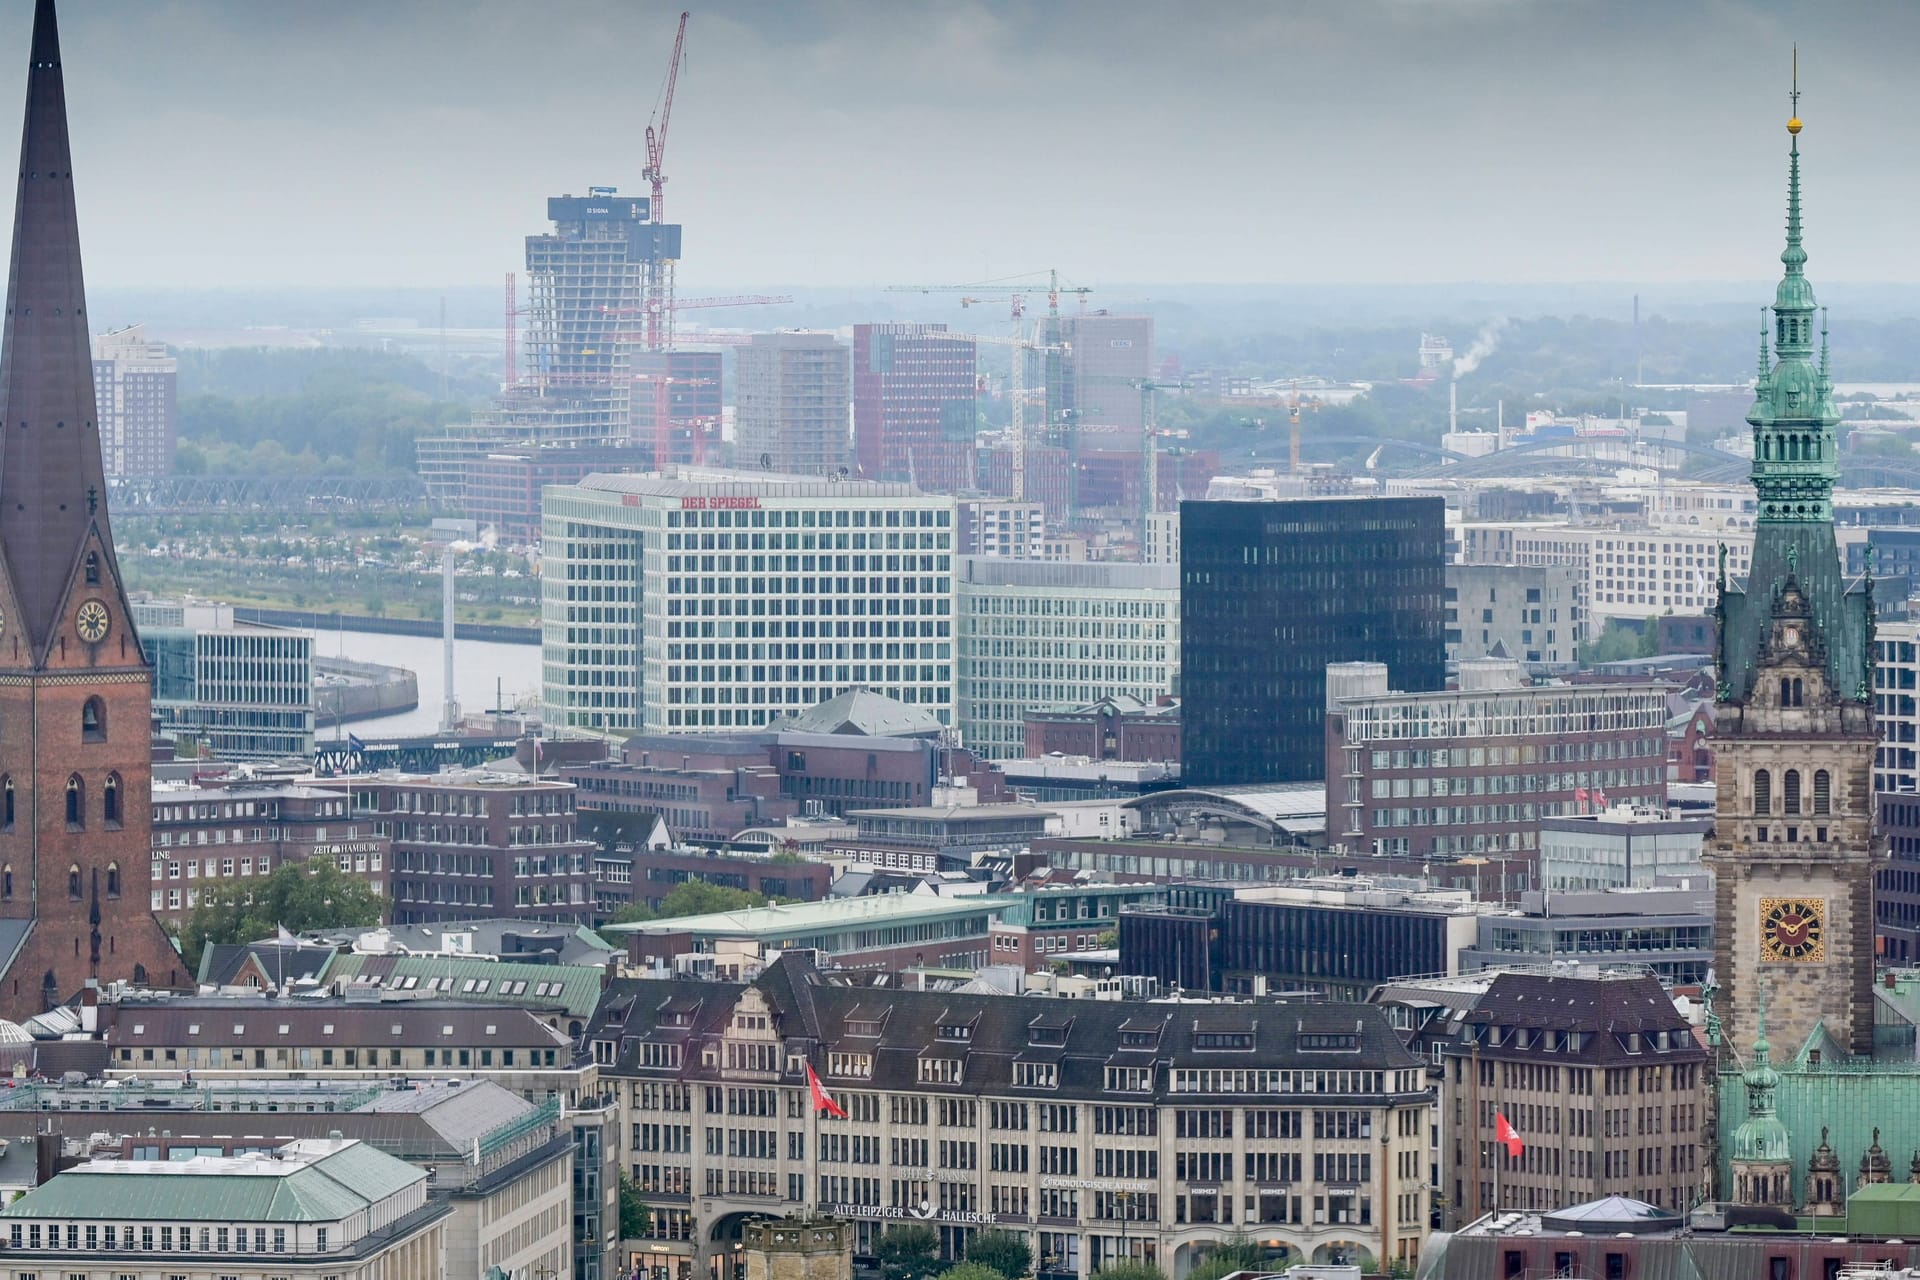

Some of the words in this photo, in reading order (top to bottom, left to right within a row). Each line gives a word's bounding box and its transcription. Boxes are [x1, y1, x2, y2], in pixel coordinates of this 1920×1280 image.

[682, 497, 706, 509] DER
[710, 497, 761, 509] SPIEGEL
[313, 846, 331, 854] ZEIT
[341, 843, 379, 853] HAMBURG
[936, 1171, 968, 1182] BANK
[834, 1206, 854, 1215] ALTE
[857, 1207, 903, 1218] LEIPZIGER
[942, 1211, 997, 1224] HALLESCHE
